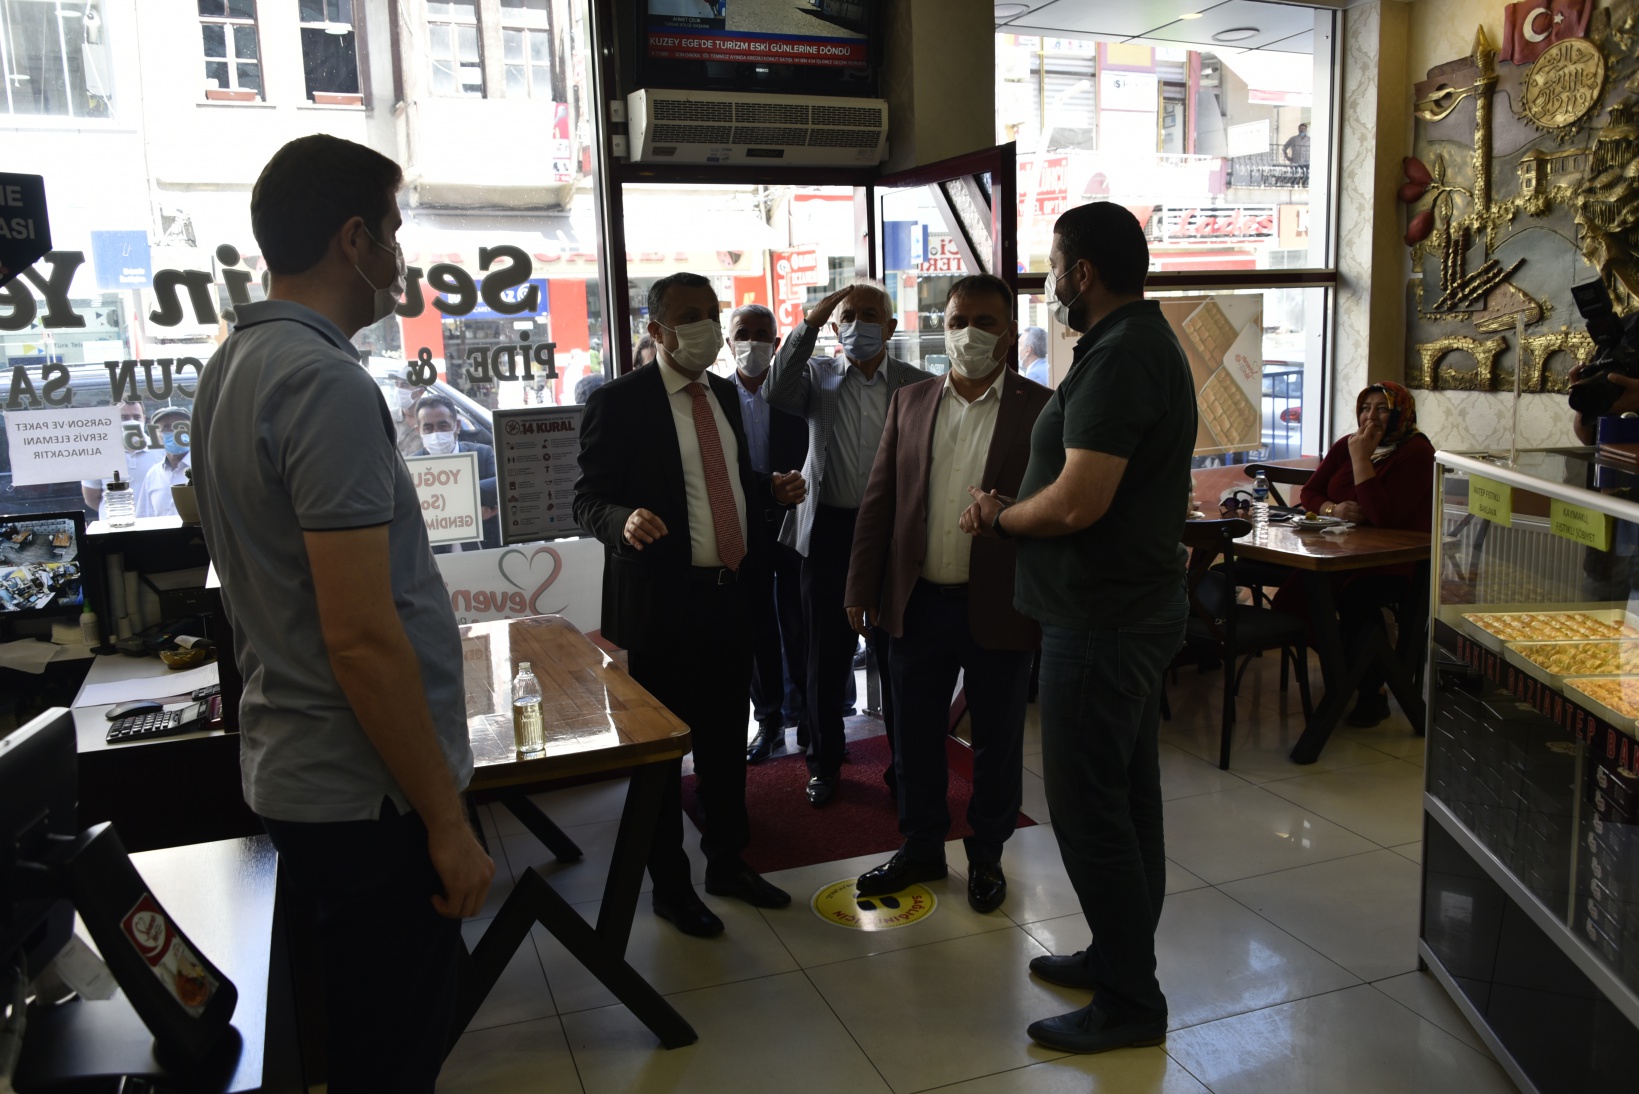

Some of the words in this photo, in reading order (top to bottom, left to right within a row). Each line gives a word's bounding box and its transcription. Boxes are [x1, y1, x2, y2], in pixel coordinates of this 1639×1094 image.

[650, 37, 680, 47] KUZEY
[682, 39, 713, 49] EGE'DE
[715, 39, 748, 50] TURİZM
[750, 42, 769, 51] ESKİ
[771, 43, 818, 54] GÜNLERİNE
[820, 45, 850, 55] DÖNDÜ
[521, 422, 535, 435] 14
[536, 421, 576, 434] KURAL
[1456, 635, 1500, 684] HAKİKİ
[1507, 667, 1596, 745] GAZİANTEP
